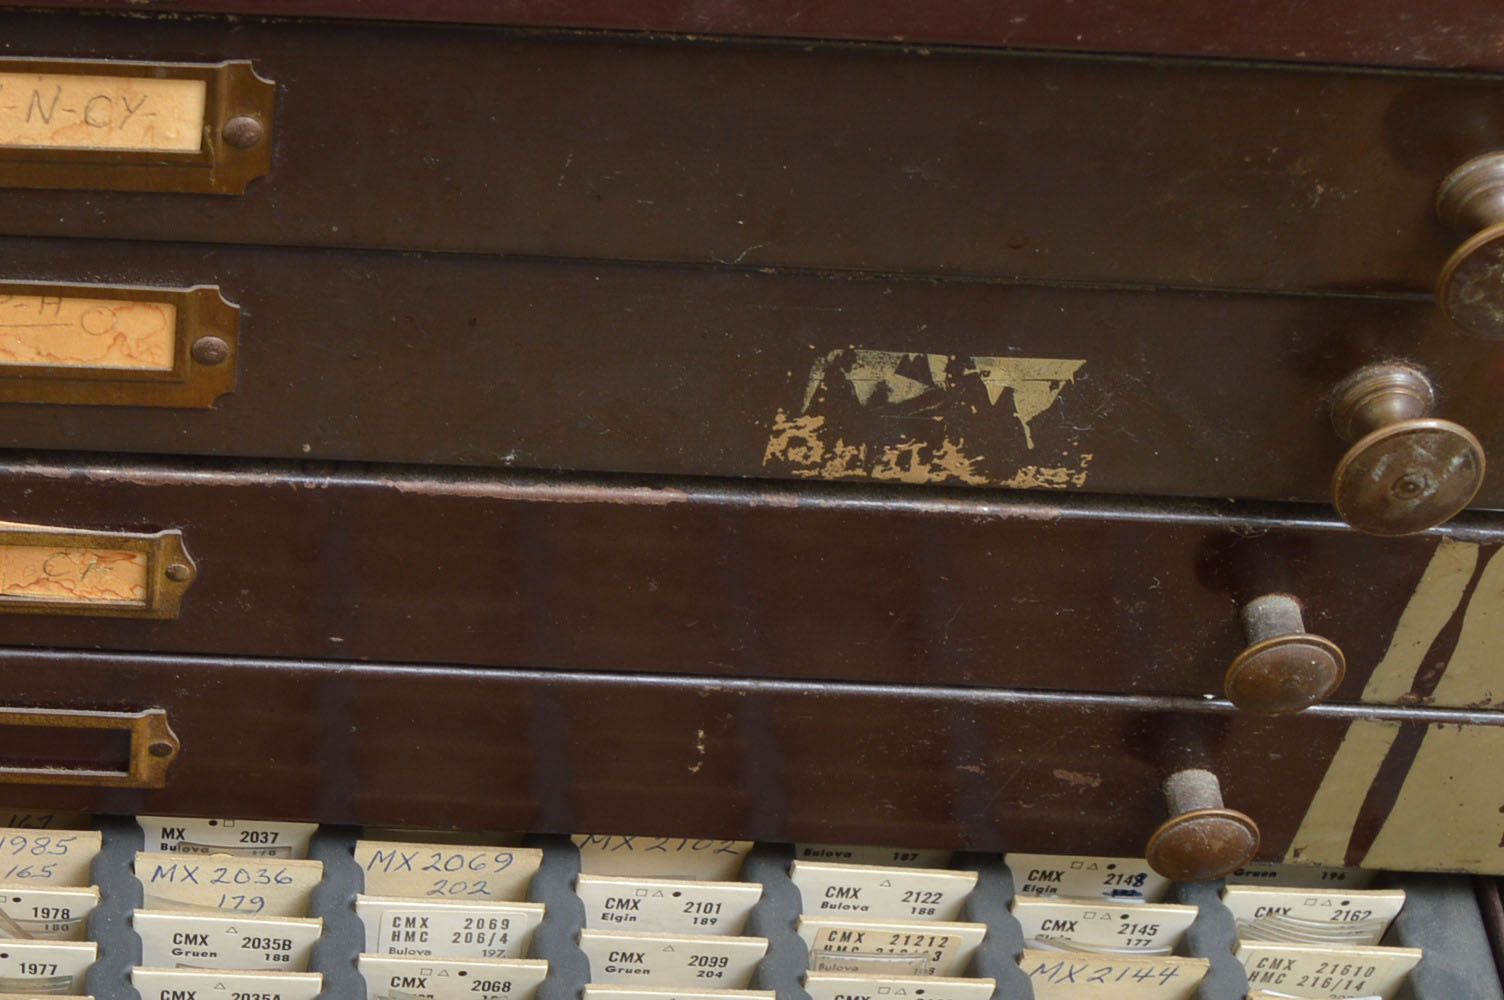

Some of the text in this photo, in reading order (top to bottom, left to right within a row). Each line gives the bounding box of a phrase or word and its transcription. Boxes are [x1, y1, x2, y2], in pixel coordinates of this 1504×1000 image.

[4, 863, 57, 879] 165
[825, 886, 943, 904] CMX 2122
[821, 901, 936, 915] Bulova 188
